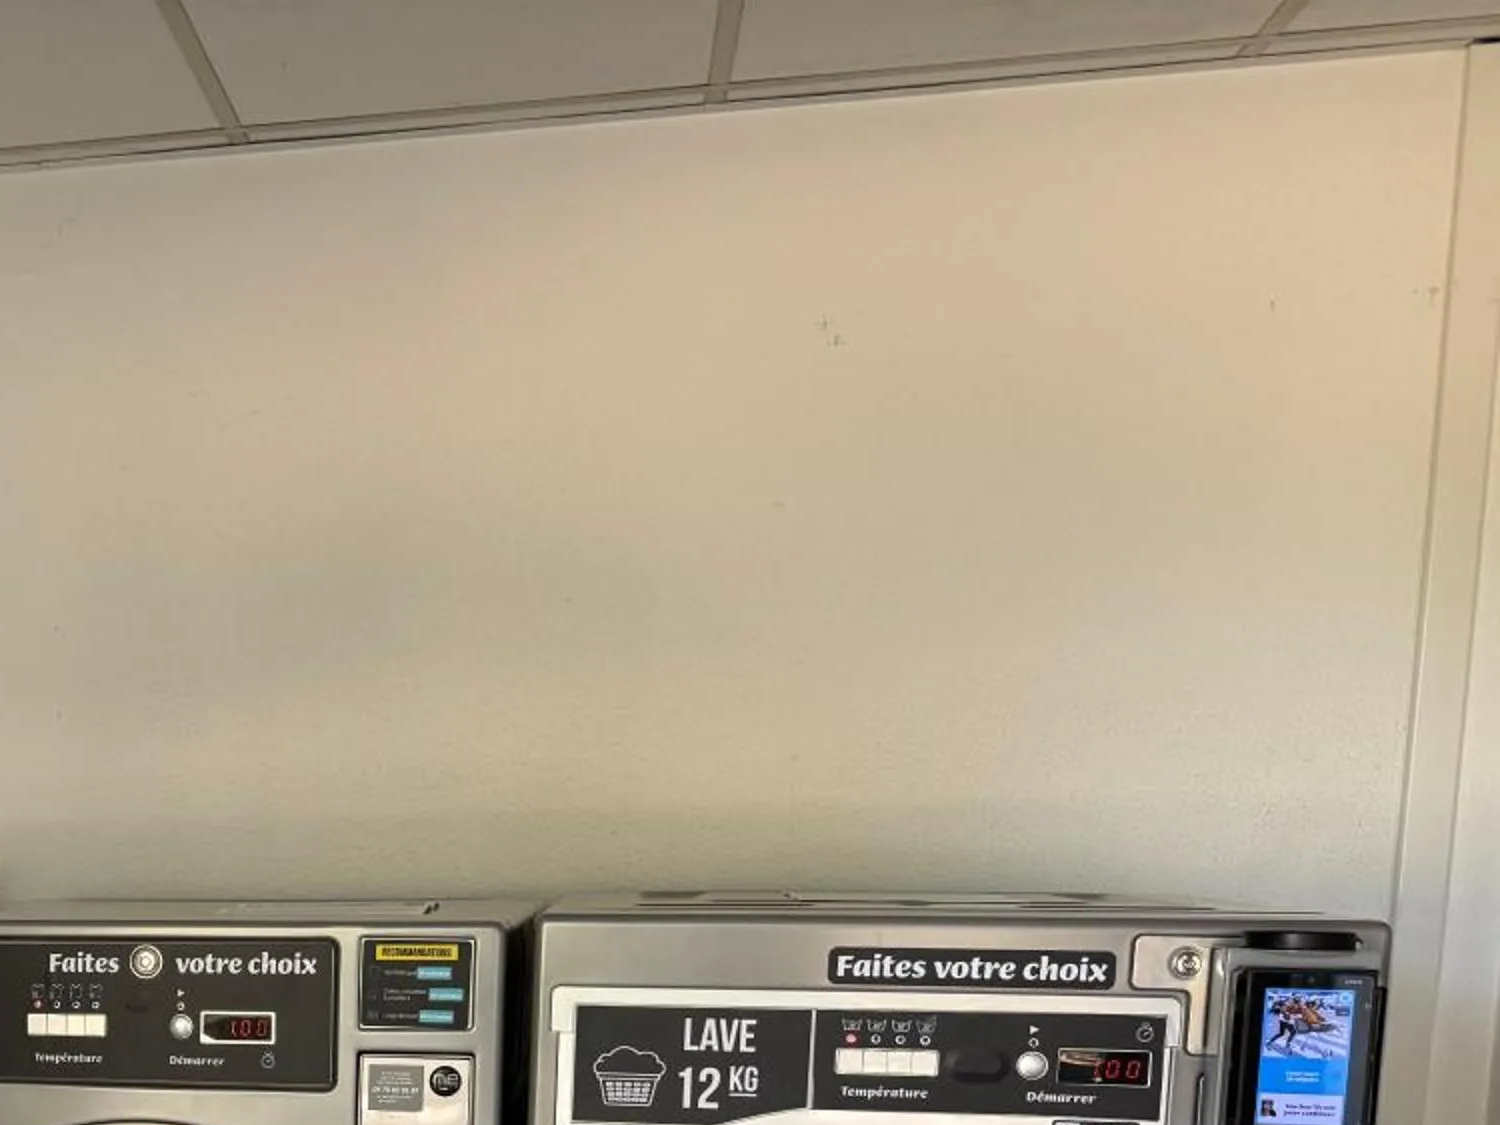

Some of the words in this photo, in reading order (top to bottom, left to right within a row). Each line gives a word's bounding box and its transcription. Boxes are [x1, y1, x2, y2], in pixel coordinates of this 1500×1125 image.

[48, 952, 120, 974] Faites
[175, 954, 242, 975] votre
[247, 952, 317, 975] choix
[836, 953, 927, 979] Faites
[934, 959, 1016, 981] votre
[1023, 956, 1109, 982] choix
[683, 1017, 757, 1053] LAVE
[35, 1052, 103, 1065] Température
[169, 1053, 225, 1066] Démarrer
[678, 1066, 721, 1109] 12
[729, 1065, 759, 1092] KG
[841, 1085, 929, 1101] Température
[1026, 1091, 1097, 1105] Démarrer
